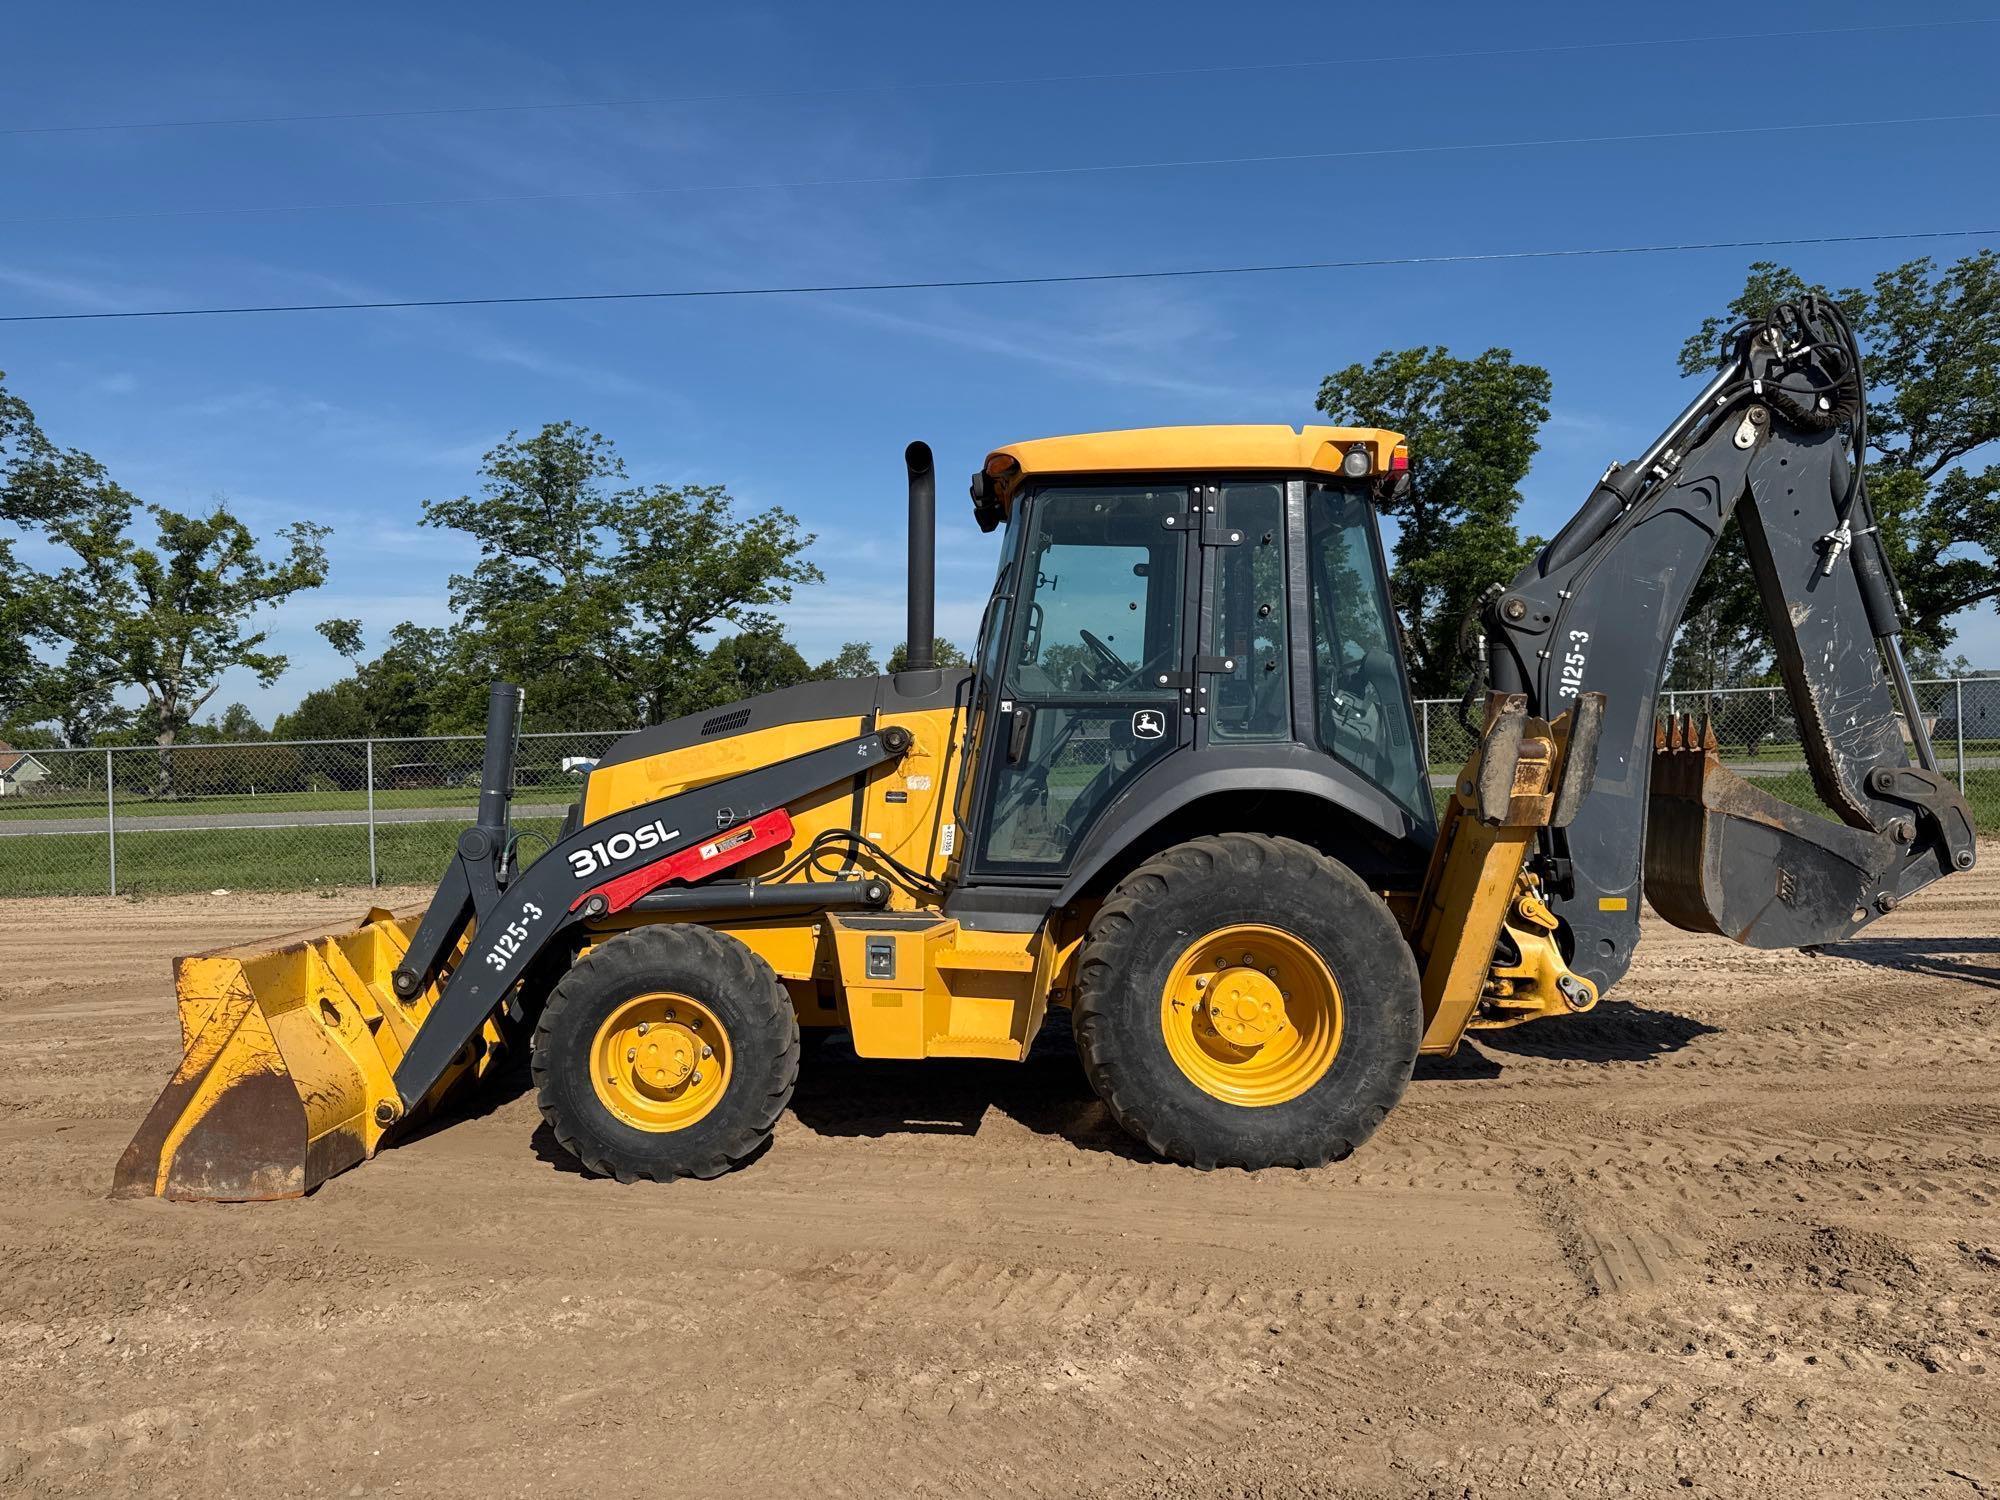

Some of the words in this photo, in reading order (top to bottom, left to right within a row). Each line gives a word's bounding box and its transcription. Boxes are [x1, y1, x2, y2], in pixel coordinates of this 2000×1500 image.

[1559, 630, 1589, 699] 3125-3
[568, 819, 680, 878] 310SL
[487, 902, 543, 971] 3125-3
